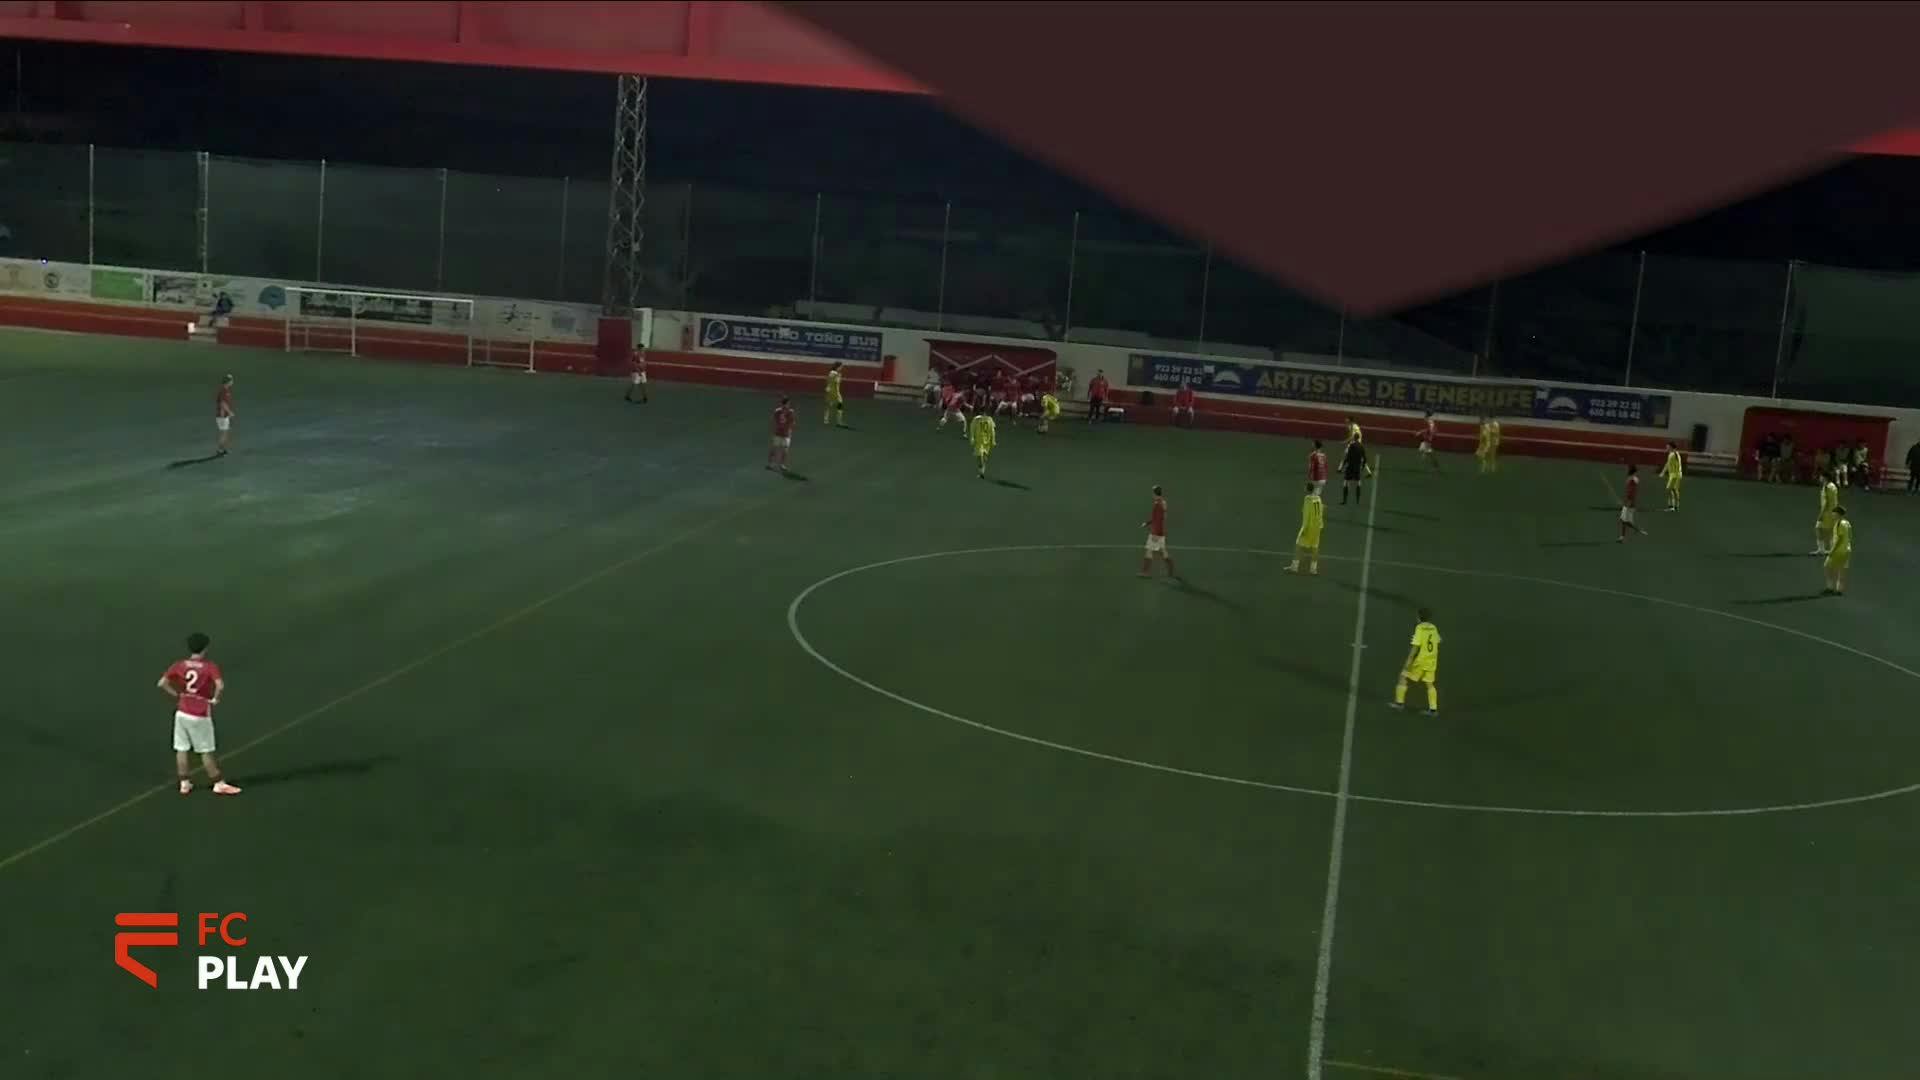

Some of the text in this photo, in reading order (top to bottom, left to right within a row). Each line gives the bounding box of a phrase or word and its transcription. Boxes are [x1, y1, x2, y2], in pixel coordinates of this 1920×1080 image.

[1256, 370, 1369, 397] ARTISTAS
[1376, 380, 1406, 401] DE
[1412, 383, 1533, 408] TENERIFE
[1427, 634, 1434, 652] 6
[185, 669, 199, 694] 2
